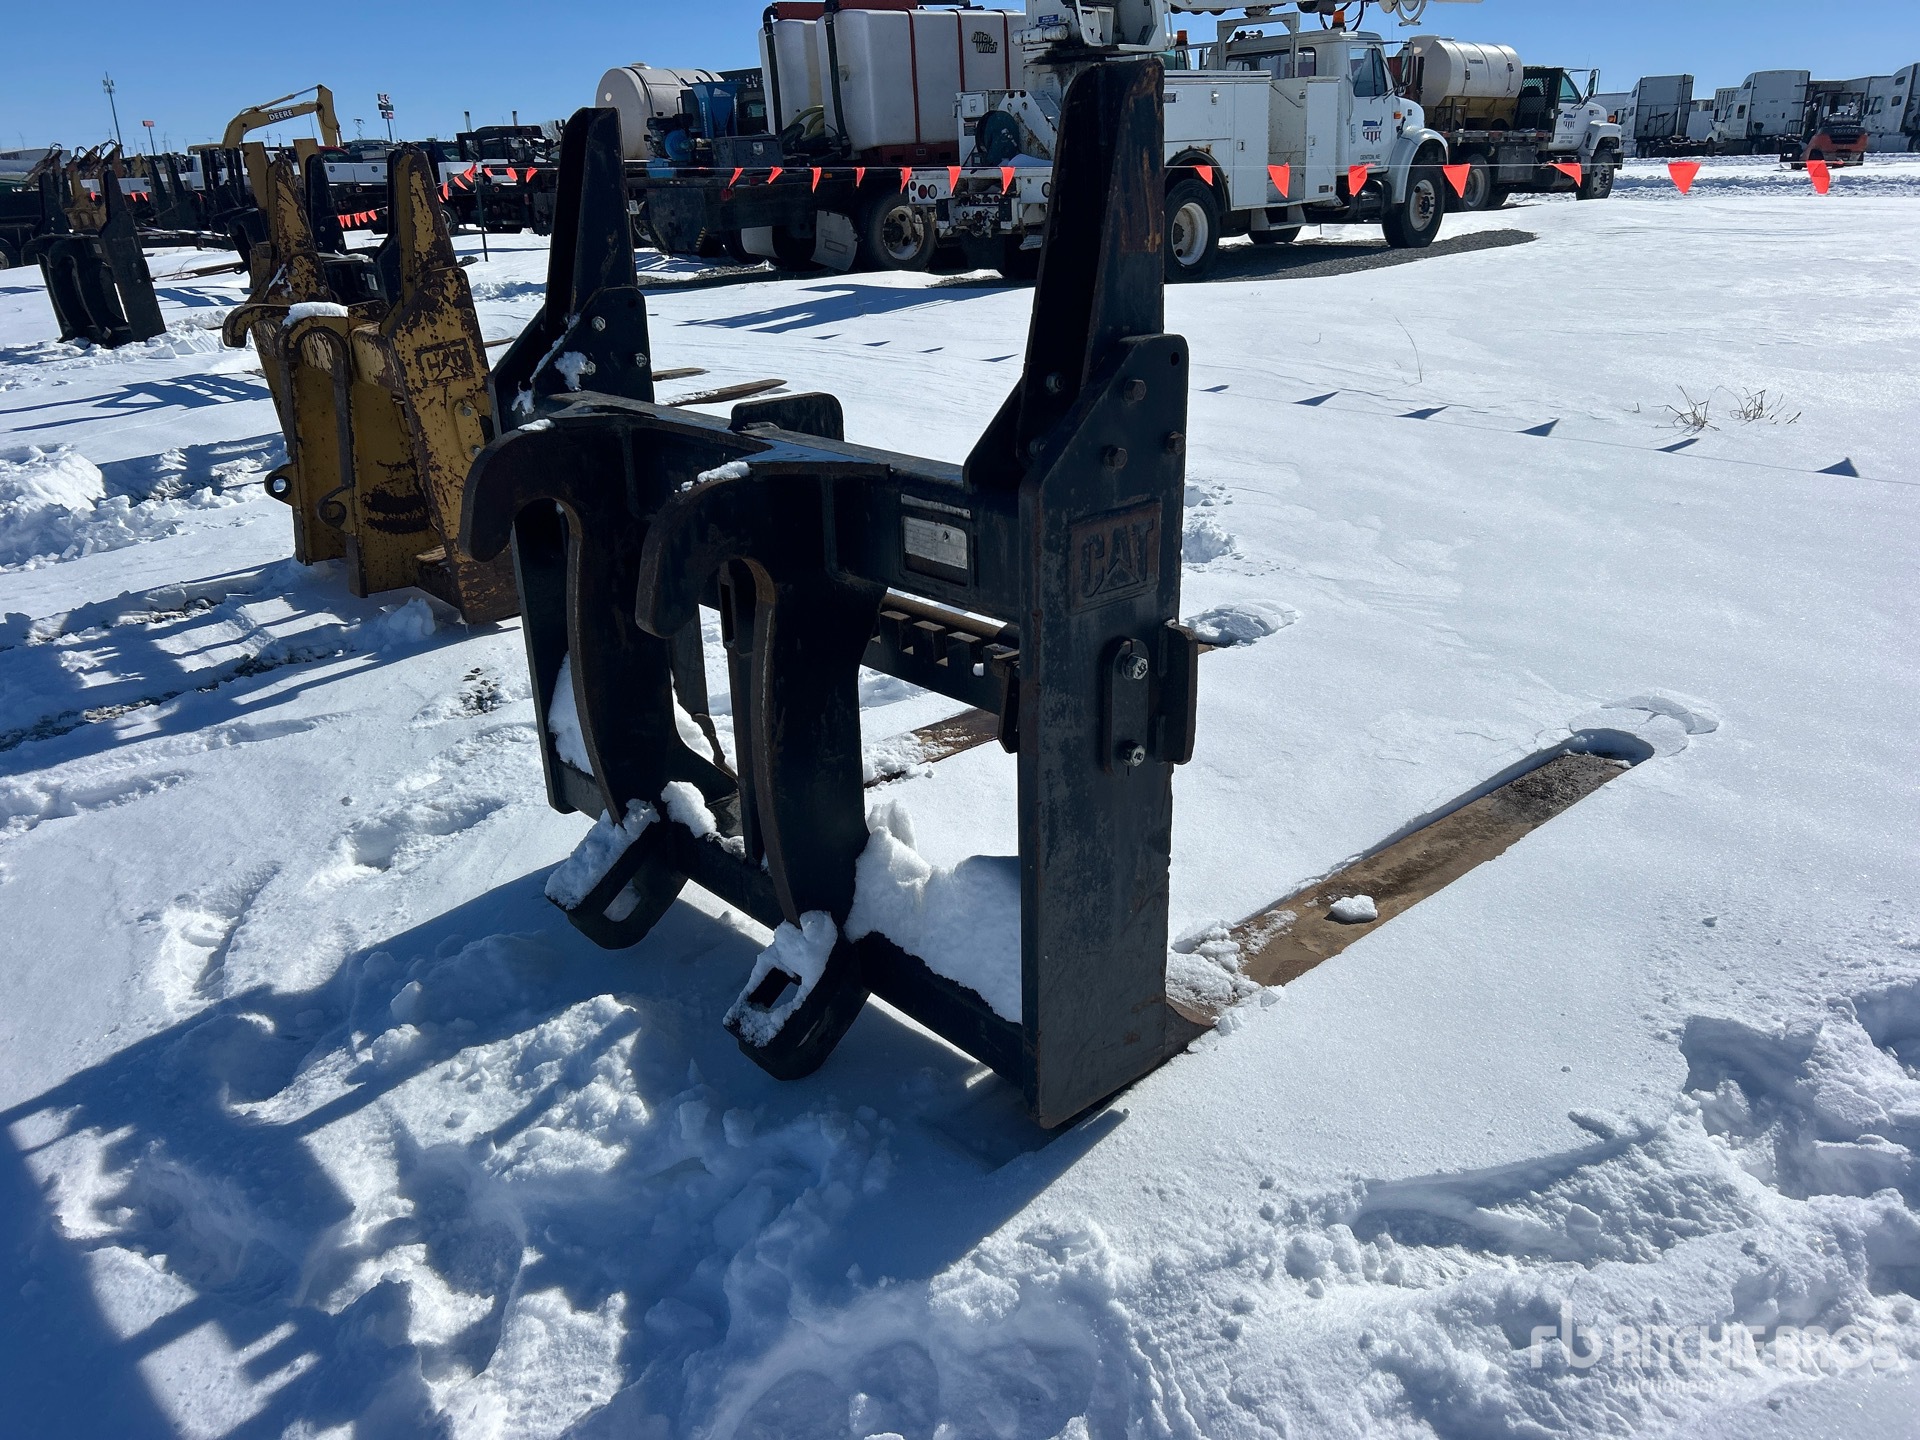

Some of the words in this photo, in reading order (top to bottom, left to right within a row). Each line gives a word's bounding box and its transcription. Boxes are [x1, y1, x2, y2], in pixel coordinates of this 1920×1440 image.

[971, 31, 993, 43] Ditch
[268, 109, 294, 121] DEERE
[420, 344, 471, 382] CAT
[1080, 518, 1154, 598] CAT
